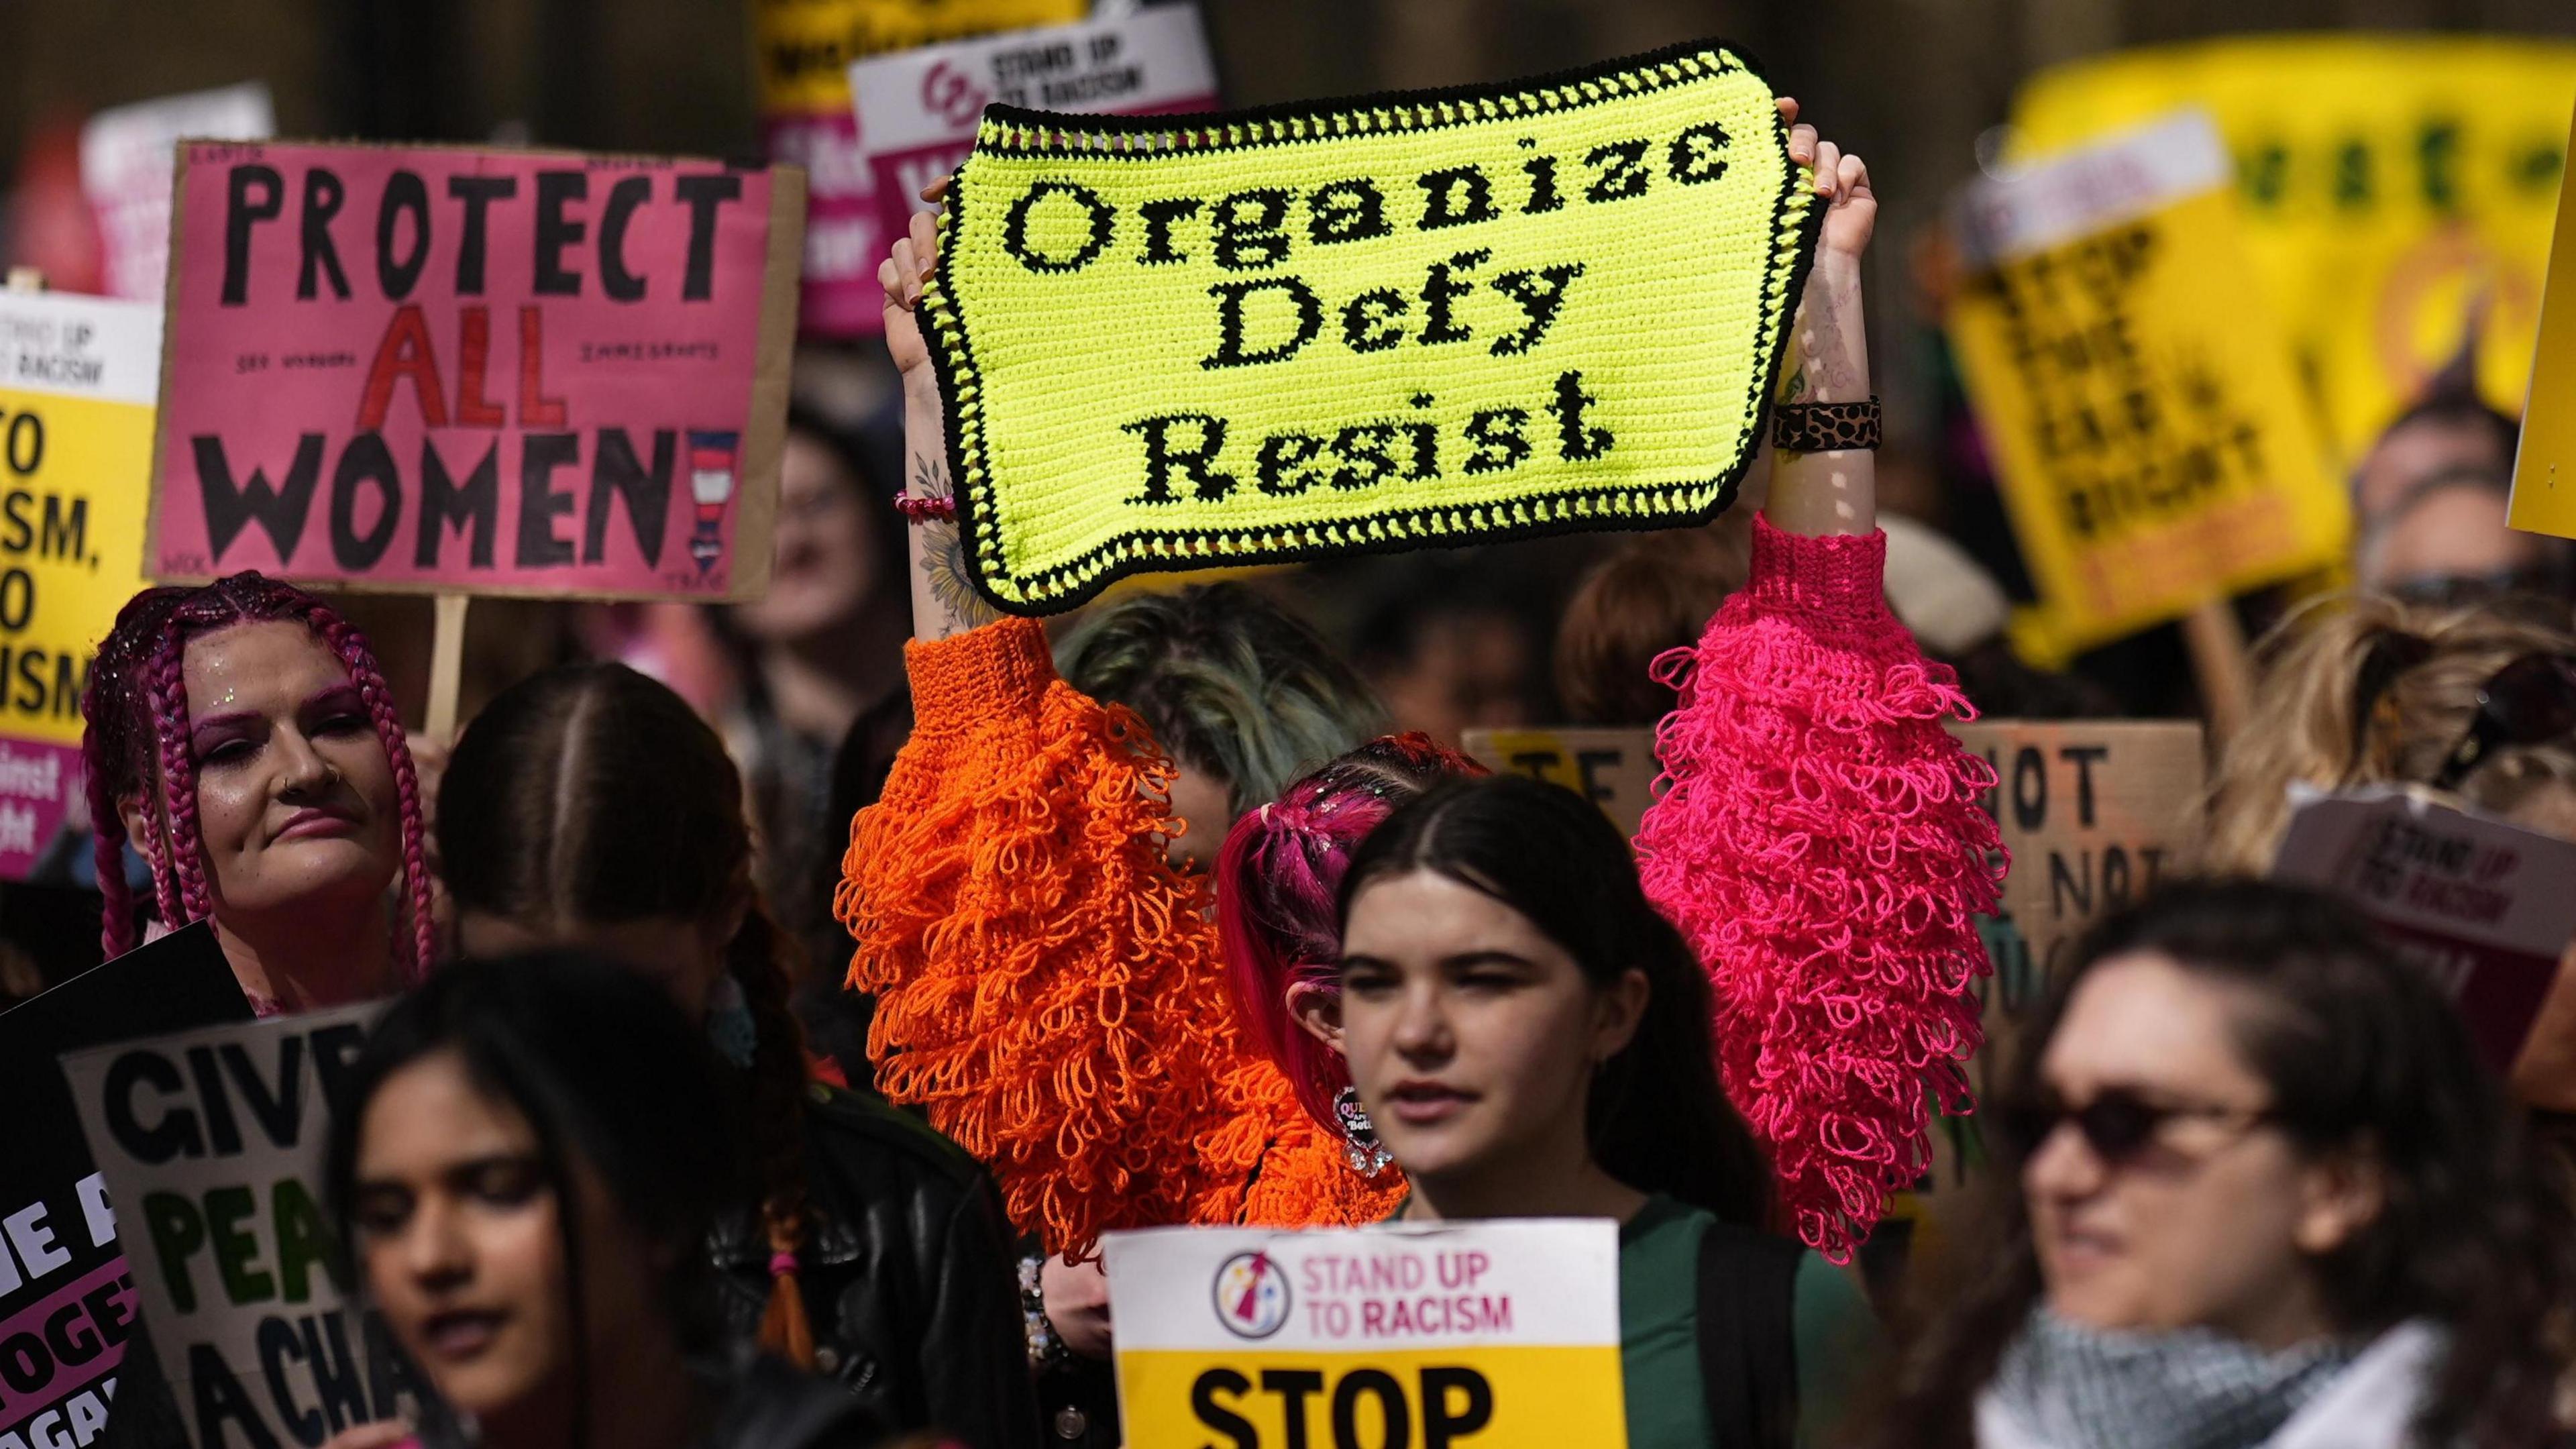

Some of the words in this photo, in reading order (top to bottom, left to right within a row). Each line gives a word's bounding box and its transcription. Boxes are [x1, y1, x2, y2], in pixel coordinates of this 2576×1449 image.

[220, 165, 742, 307] PROTECT
[1003, 119, 1734, 273] Organize
[356, 305, 568, 430] ALL
[1200, 247, 1586, 371] Defy
[0, 409, 45, 476] O
[1120, 369, 1613, 508] Resist
[1302, 1253, 1426, 1295] STAND
[1436, 1250, 1490, 1291] UP
[1305, 1299, 1351, 1338] TO
[1362, 1295, 1513, 1337] RACISM
[1191, 1366, 1493, 1449] STOP
